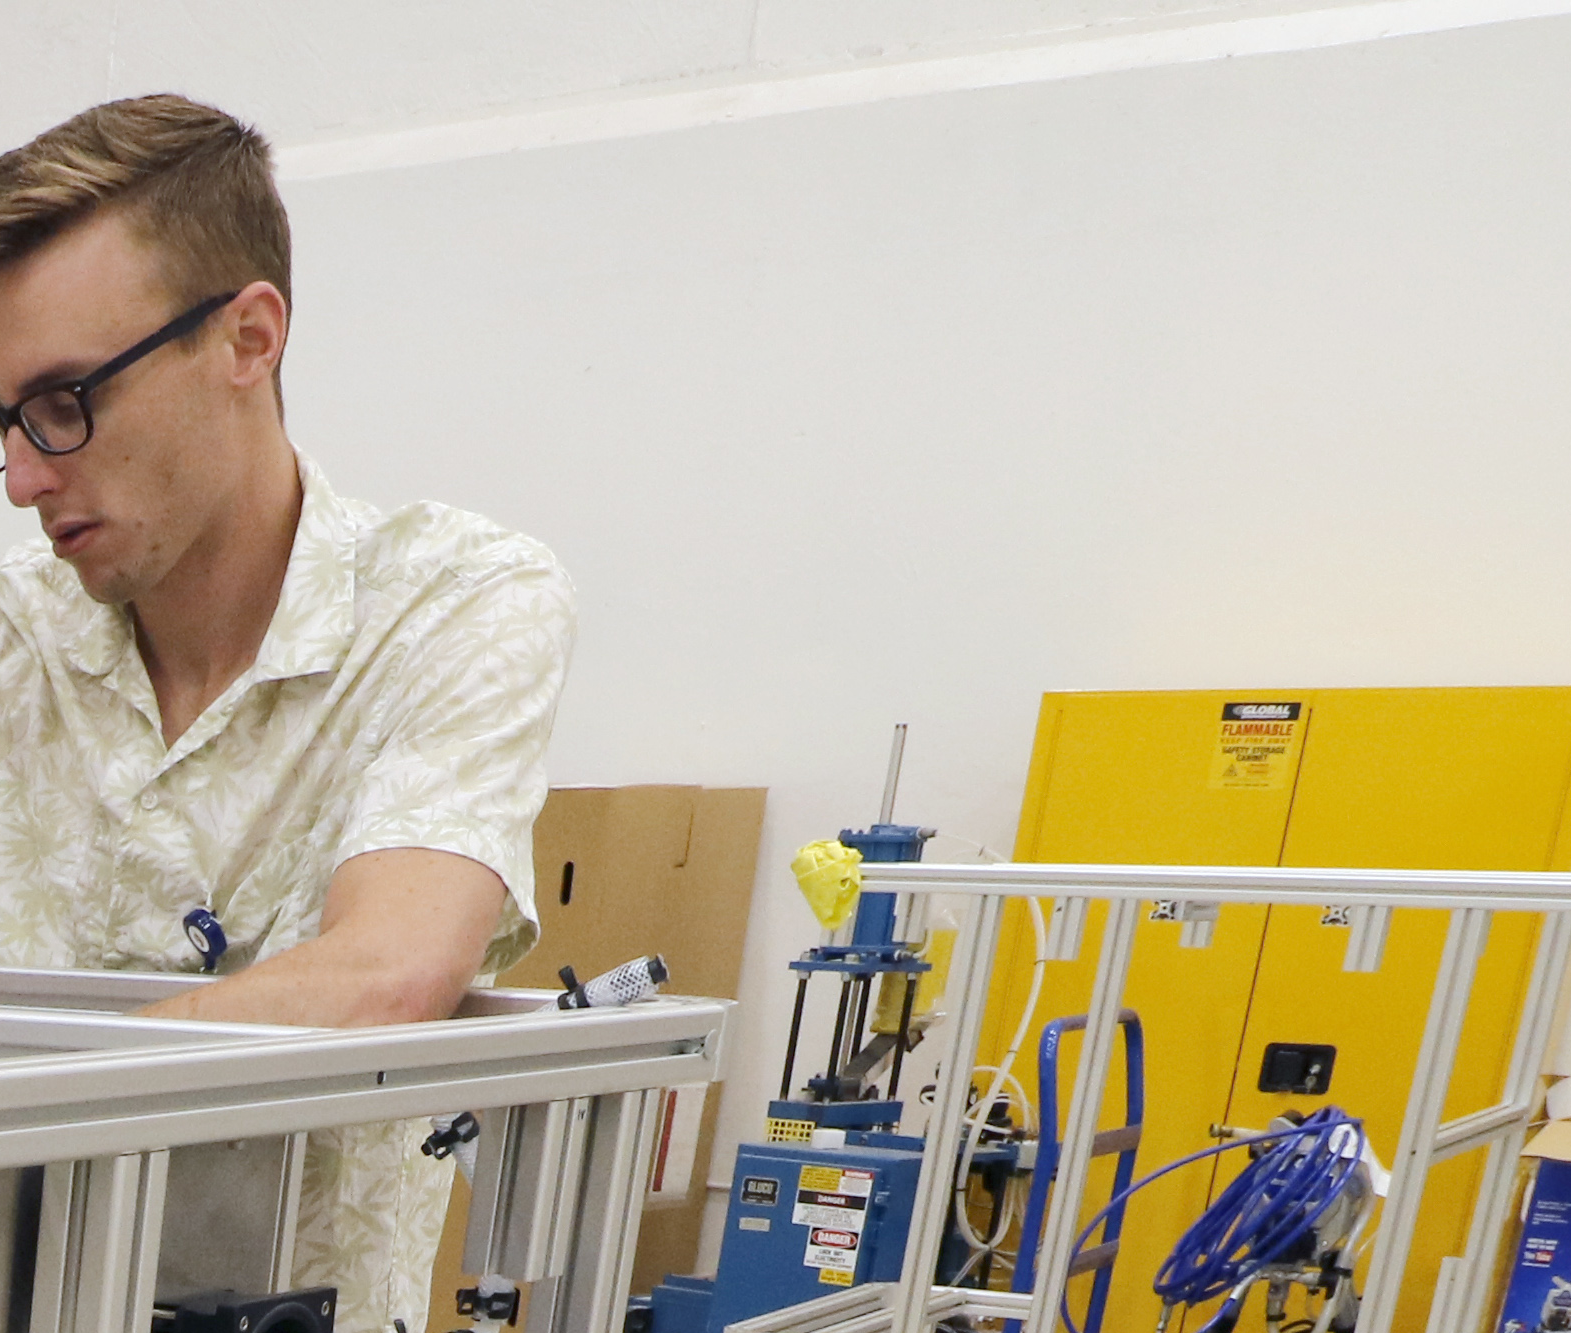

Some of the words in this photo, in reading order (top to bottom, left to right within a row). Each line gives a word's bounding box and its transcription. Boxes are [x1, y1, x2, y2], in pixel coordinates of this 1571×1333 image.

[1242, 704, 1291, 715] GLOBAL
[1221, 723, 1295, 736] FLAMMABLE
[817, 1231, 852, 1245] DANGER
